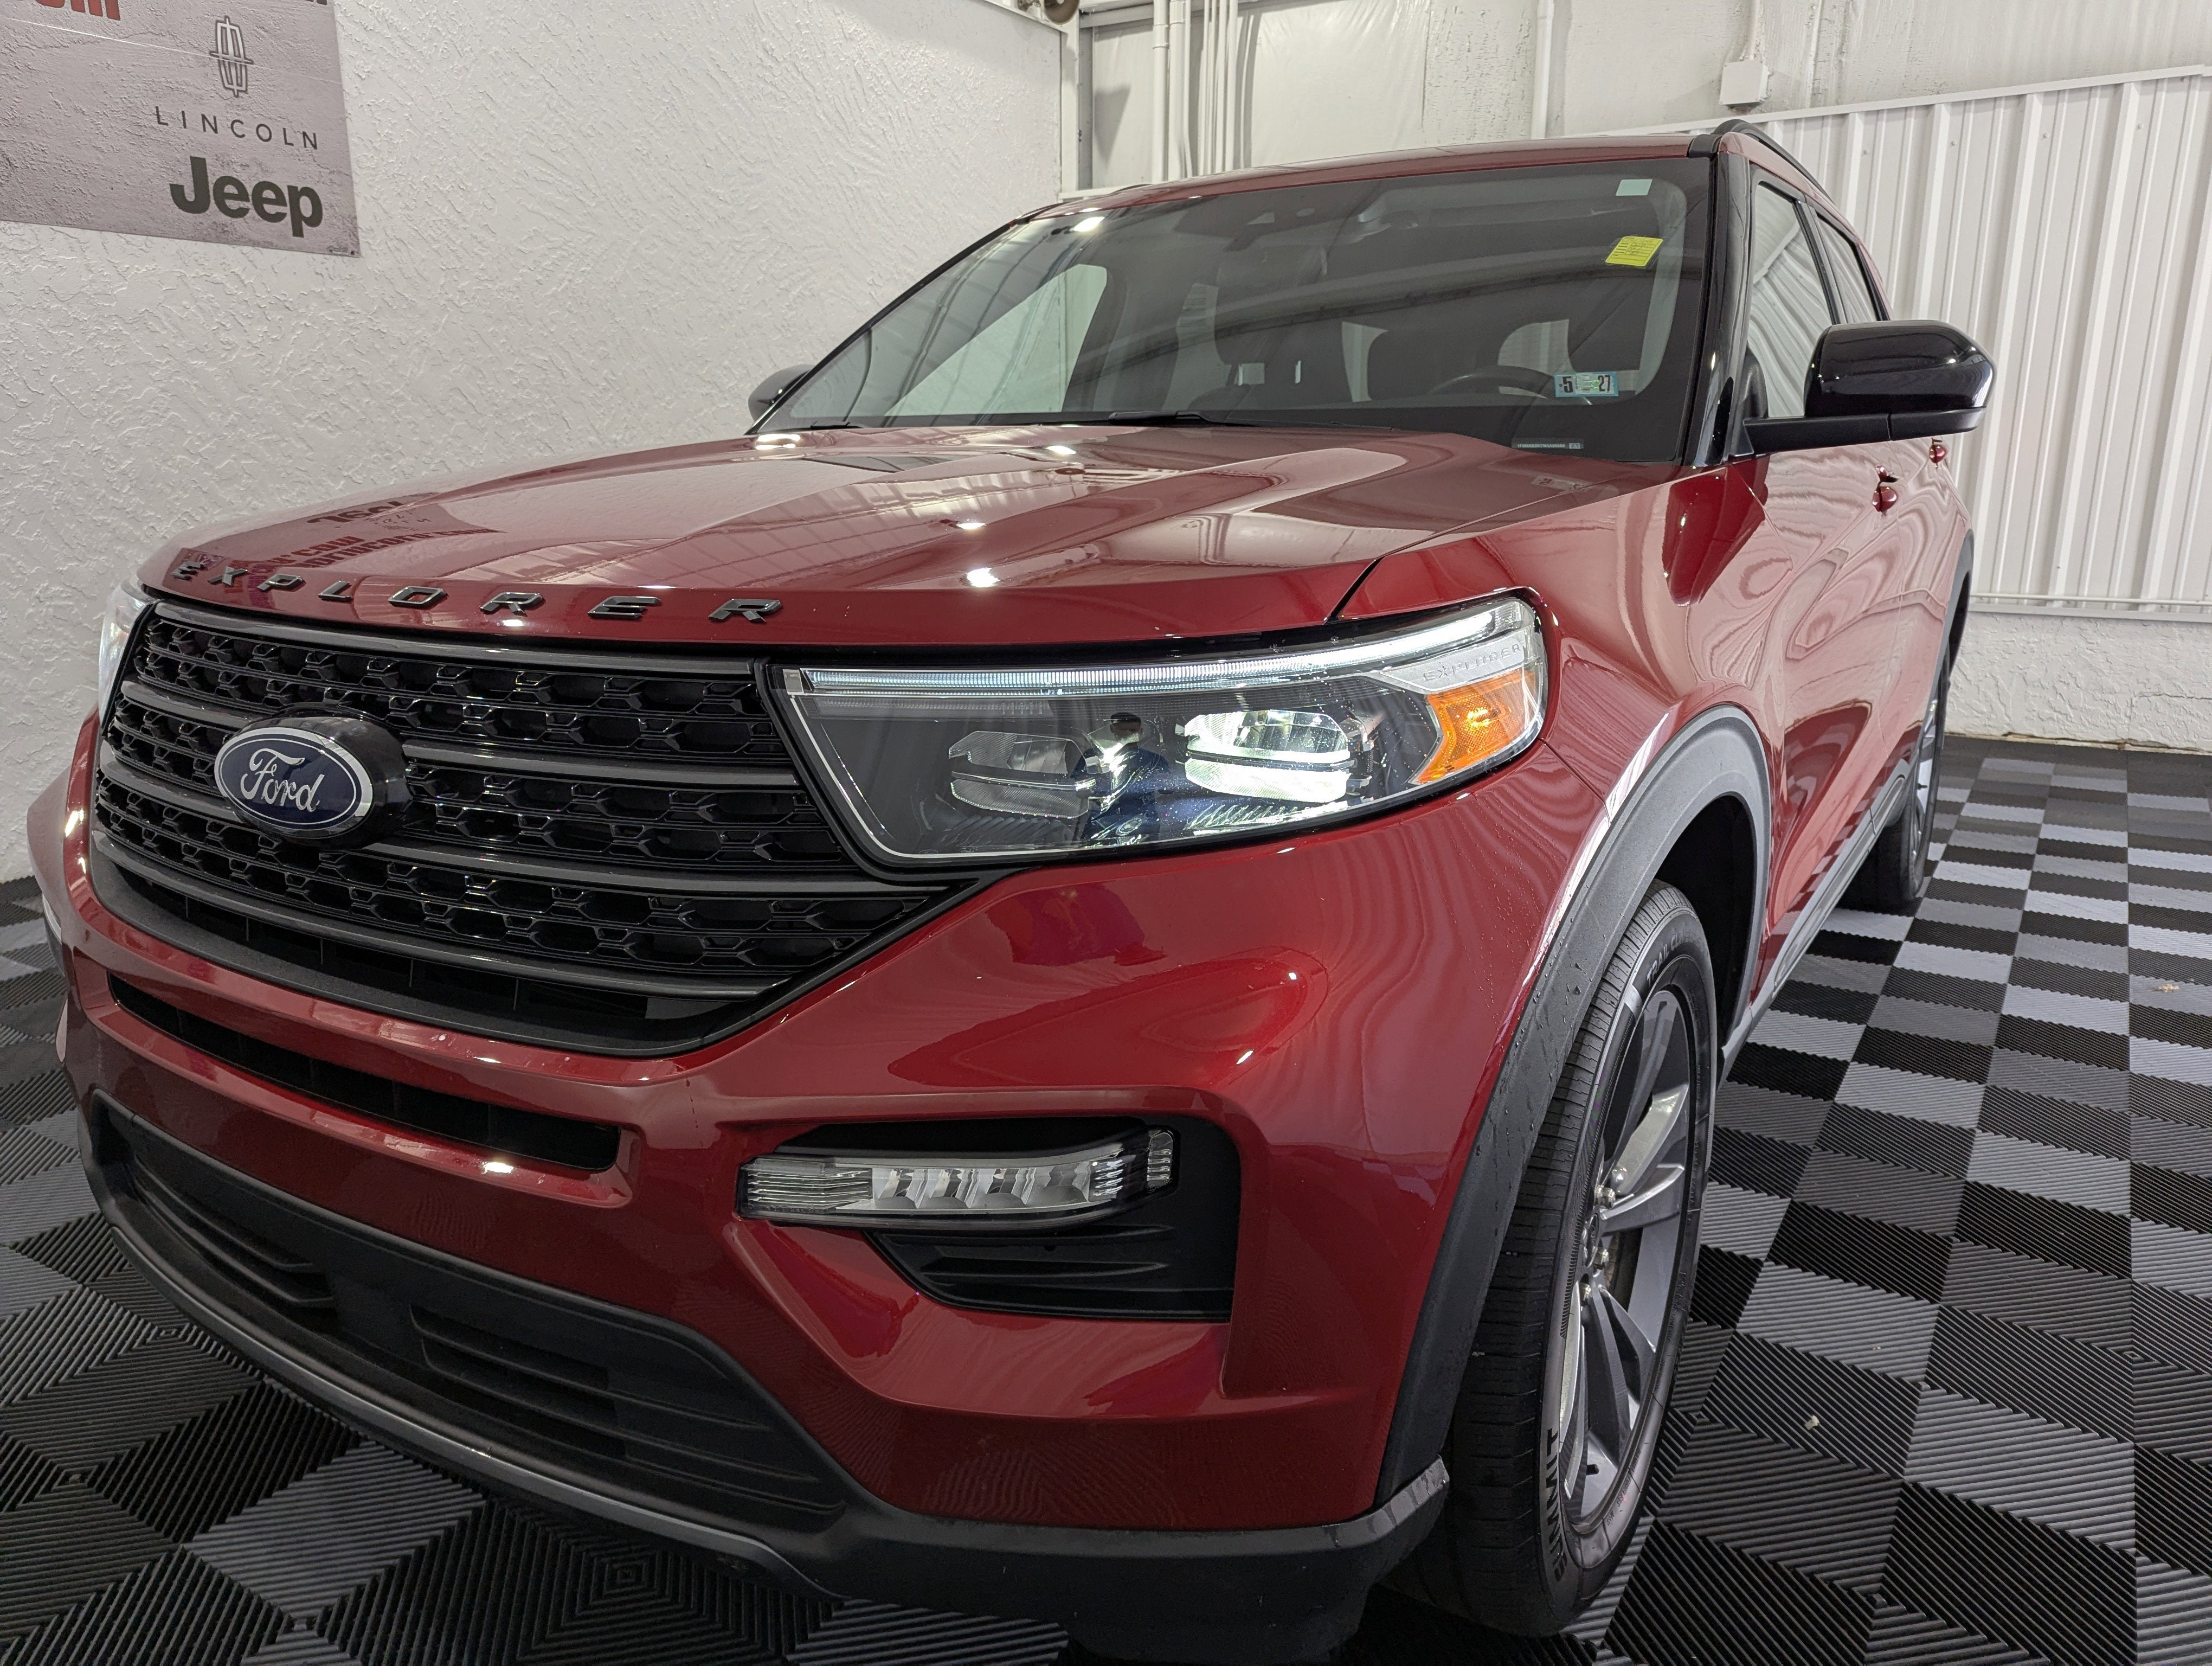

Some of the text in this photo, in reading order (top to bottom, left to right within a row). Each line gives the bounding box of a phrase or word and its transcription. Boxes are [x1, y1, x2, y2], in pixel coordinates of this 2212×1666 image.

[155, 106, 318, 150] LINCOLN
[169, 156, 323, 238] Jeep
[1562, 375, 1573, 393] 5
[1597, 375, 1611, 392] 27
[169, 560, 783, 623] EXPLORER
[1423, 643, 1521, 682] EXPLORER
[240, 748, 325, 812] Ford
[1647, 943, 1670, 987] TRAIL
[1546, 1427, 1567, 1582] SUMMIT
